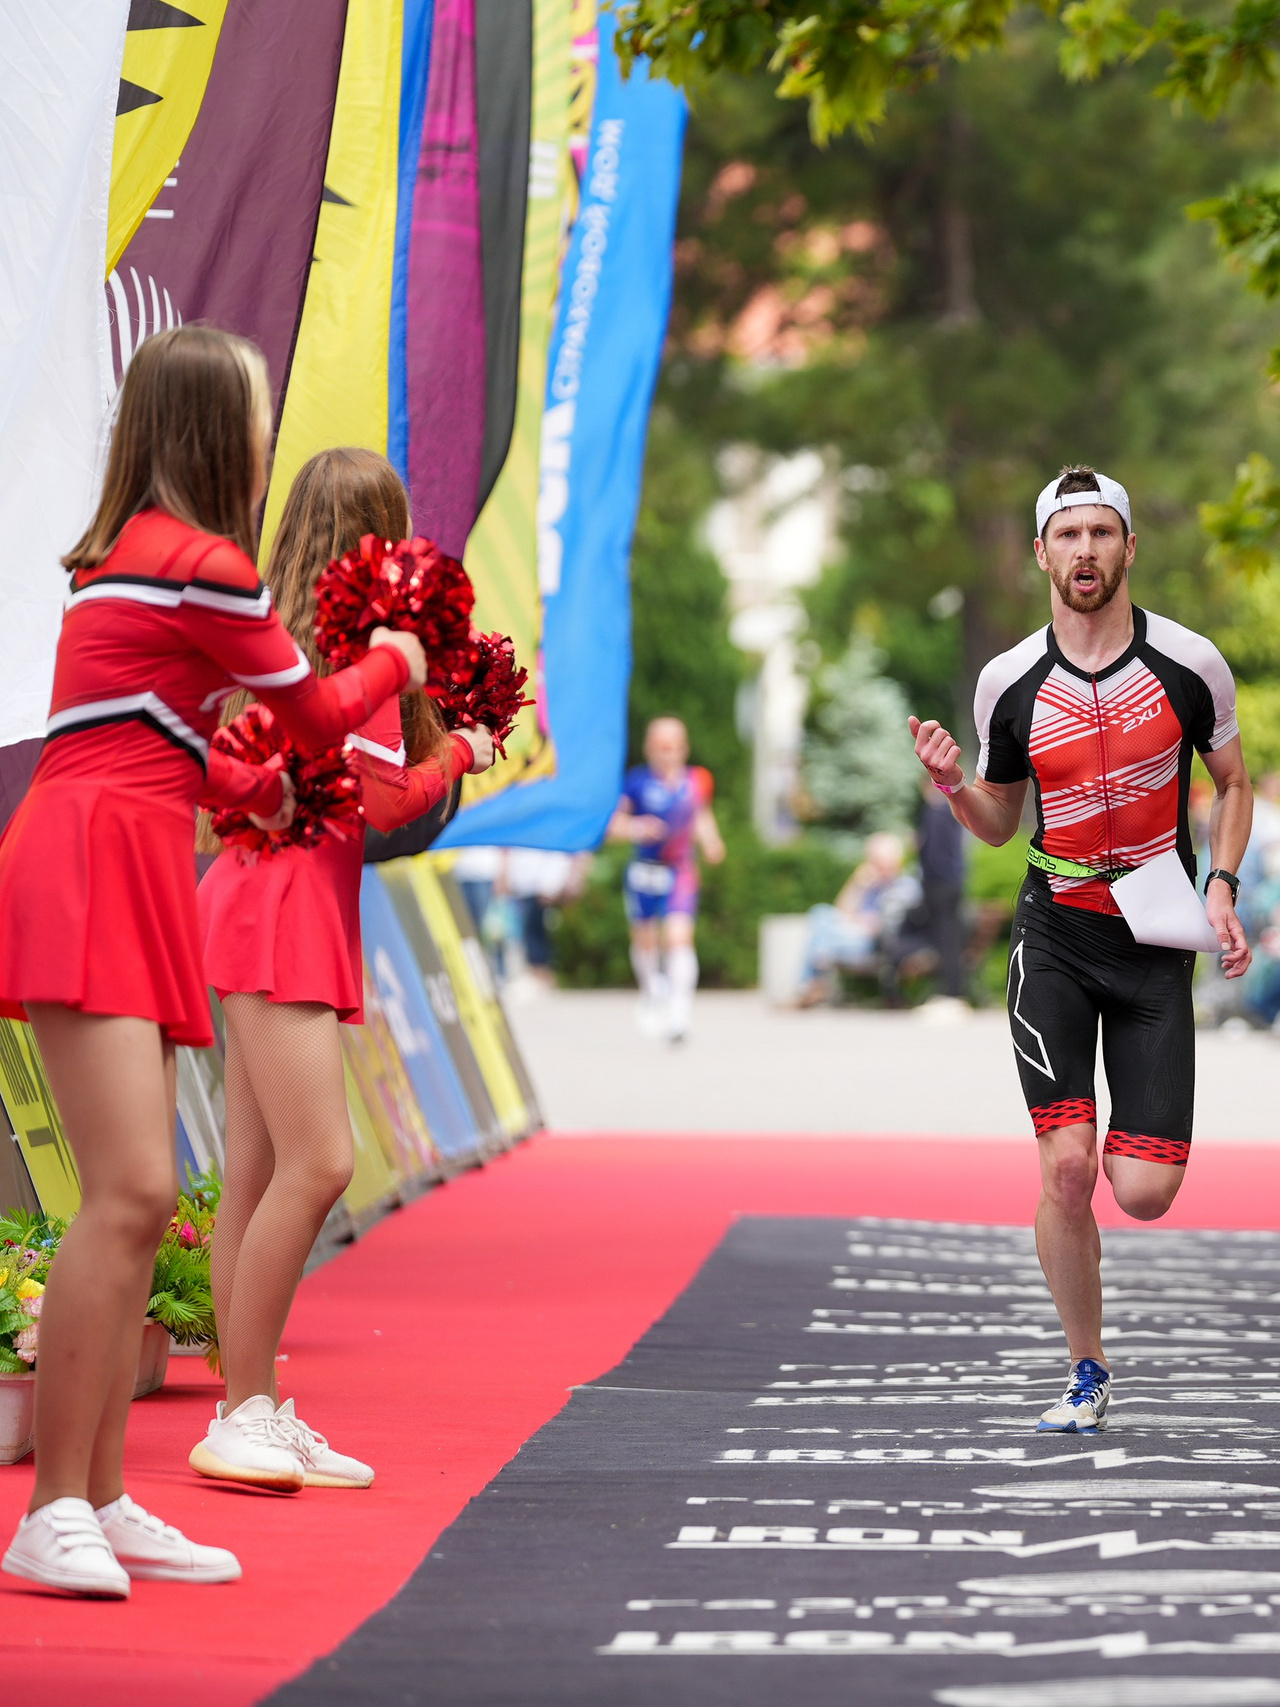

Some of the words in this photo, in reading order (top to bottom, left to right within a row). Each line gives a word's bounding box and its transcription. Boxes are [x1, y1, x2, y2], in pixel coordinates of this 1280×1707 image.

[552, 203, 611, 400] СТРАХОВОЙ
[589, 118, 626, 203] ДОМ
[1122, 702, 1162, 734] 2XU
[723, 1447, 1026, 1461] IRON
[677, 1525, 1025, 1545] IRON
[611, 1630, 1016, 1650] IRON
